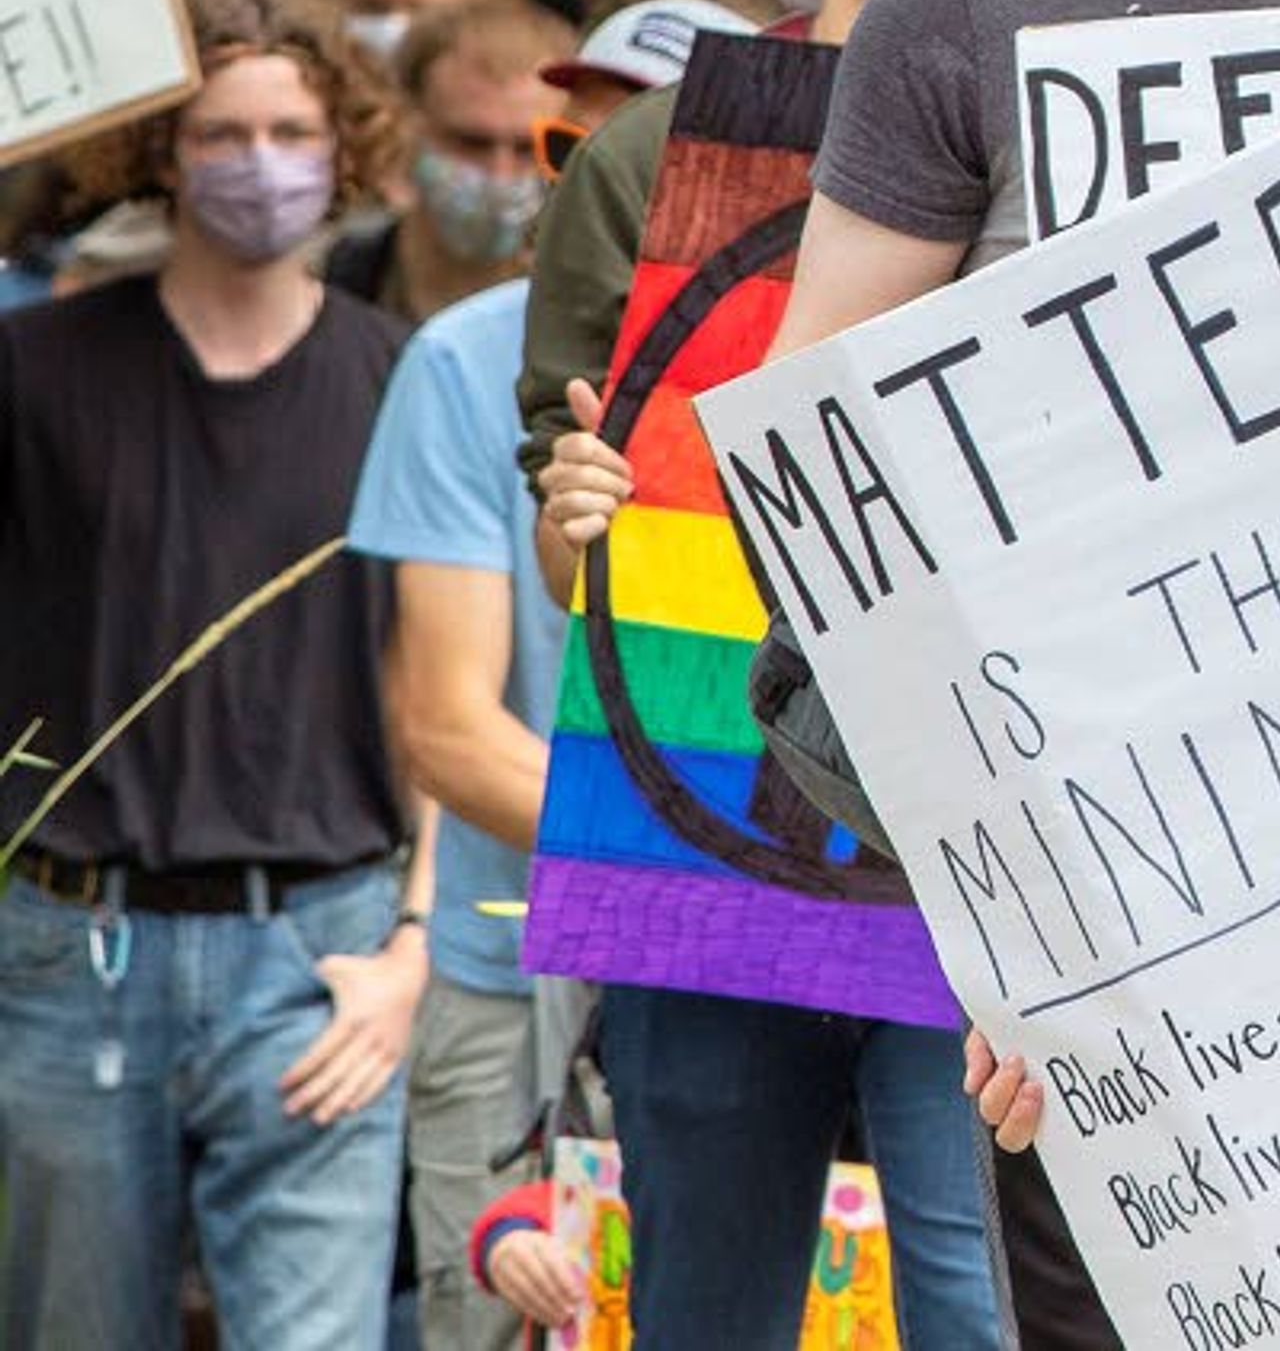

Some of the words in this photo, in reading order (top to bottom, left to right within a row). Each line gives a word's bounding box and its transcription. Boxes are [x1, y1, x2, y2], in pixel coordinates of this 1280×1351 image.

[952, 651, 1045, 778] IS
[1047, 1029, 1170, 1139] Black
[1108, 1137, 1227, 1251] Black
